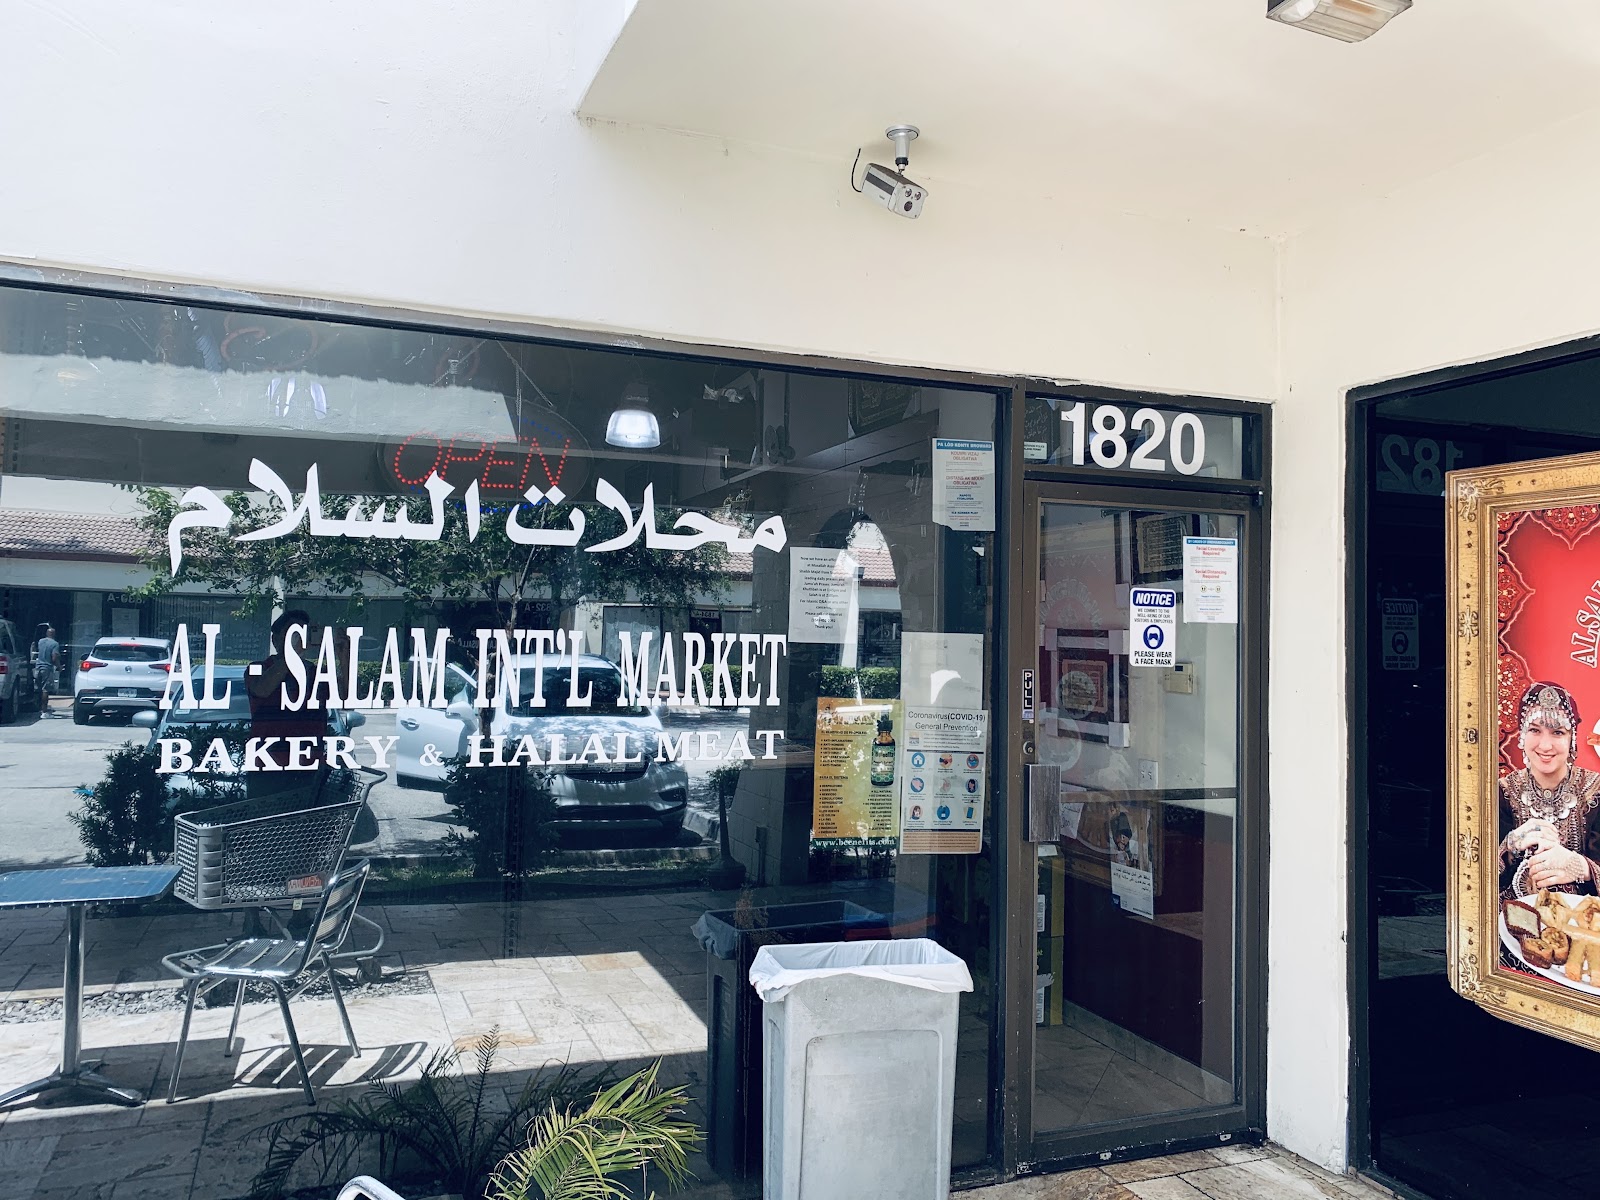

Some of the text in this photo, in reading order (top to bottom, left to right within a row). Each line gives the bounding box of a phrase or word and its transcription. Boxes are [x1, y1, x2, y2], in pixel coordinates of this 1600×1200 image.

[394, 428, 571, 489] OPEN
[1061, 402, 1206, 476] 1820
[168, 457, 788, 578] محلات السلام
[1135, 592, 1173, 606] NOTICE
[159, 623, 232, 710] AL
[280, 623, 451, 712] SALAM
[616, 631, 787, 707] MARKET
[1024, 672, 1032, 708] PULL
[155, 730, 785, 773] BAKERY & HALAL MEAT
[915, 722, 978, 732] General Prevention
